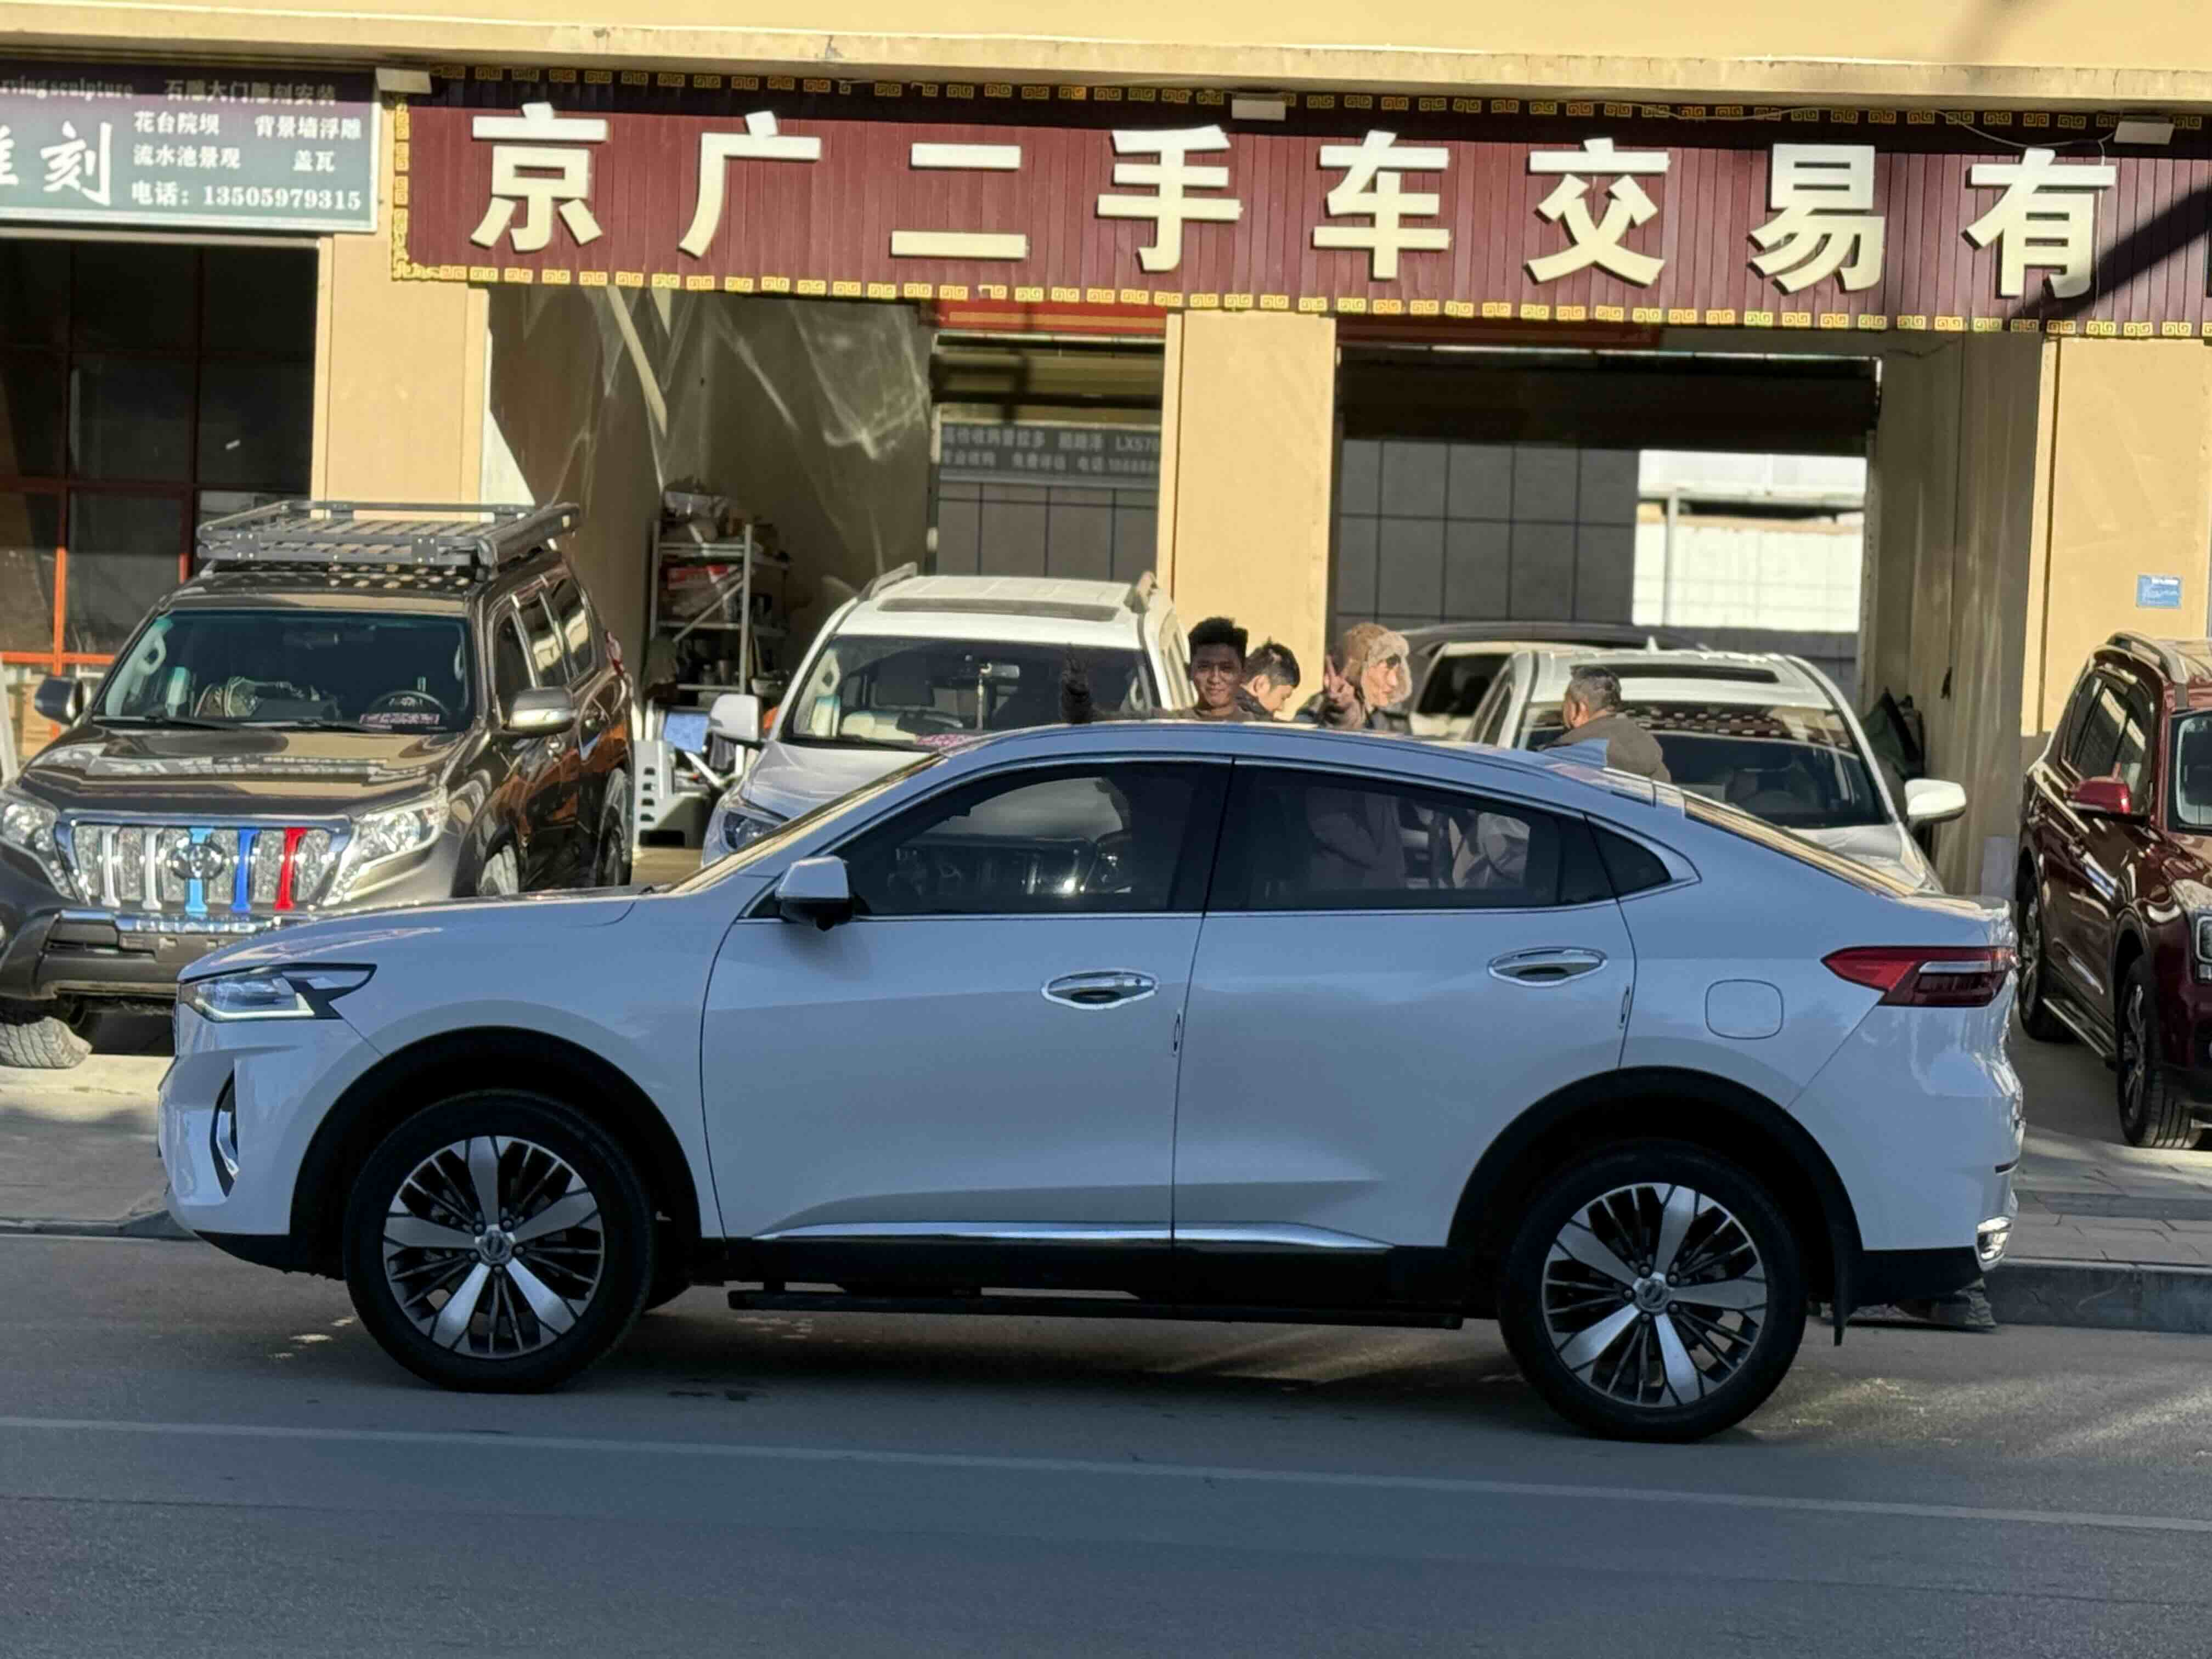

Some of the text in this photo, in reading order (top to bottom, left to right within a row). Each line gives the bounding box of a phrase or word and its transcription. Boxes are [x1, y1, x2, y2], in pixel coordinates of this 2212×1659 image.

[134, 111, 361, 139] 花台院坝 背景墙浮雕
[133, 144, 336, 172] 流水池景观 盖瓦
[470, 101, 2117, 299] 京广二手车交易有
